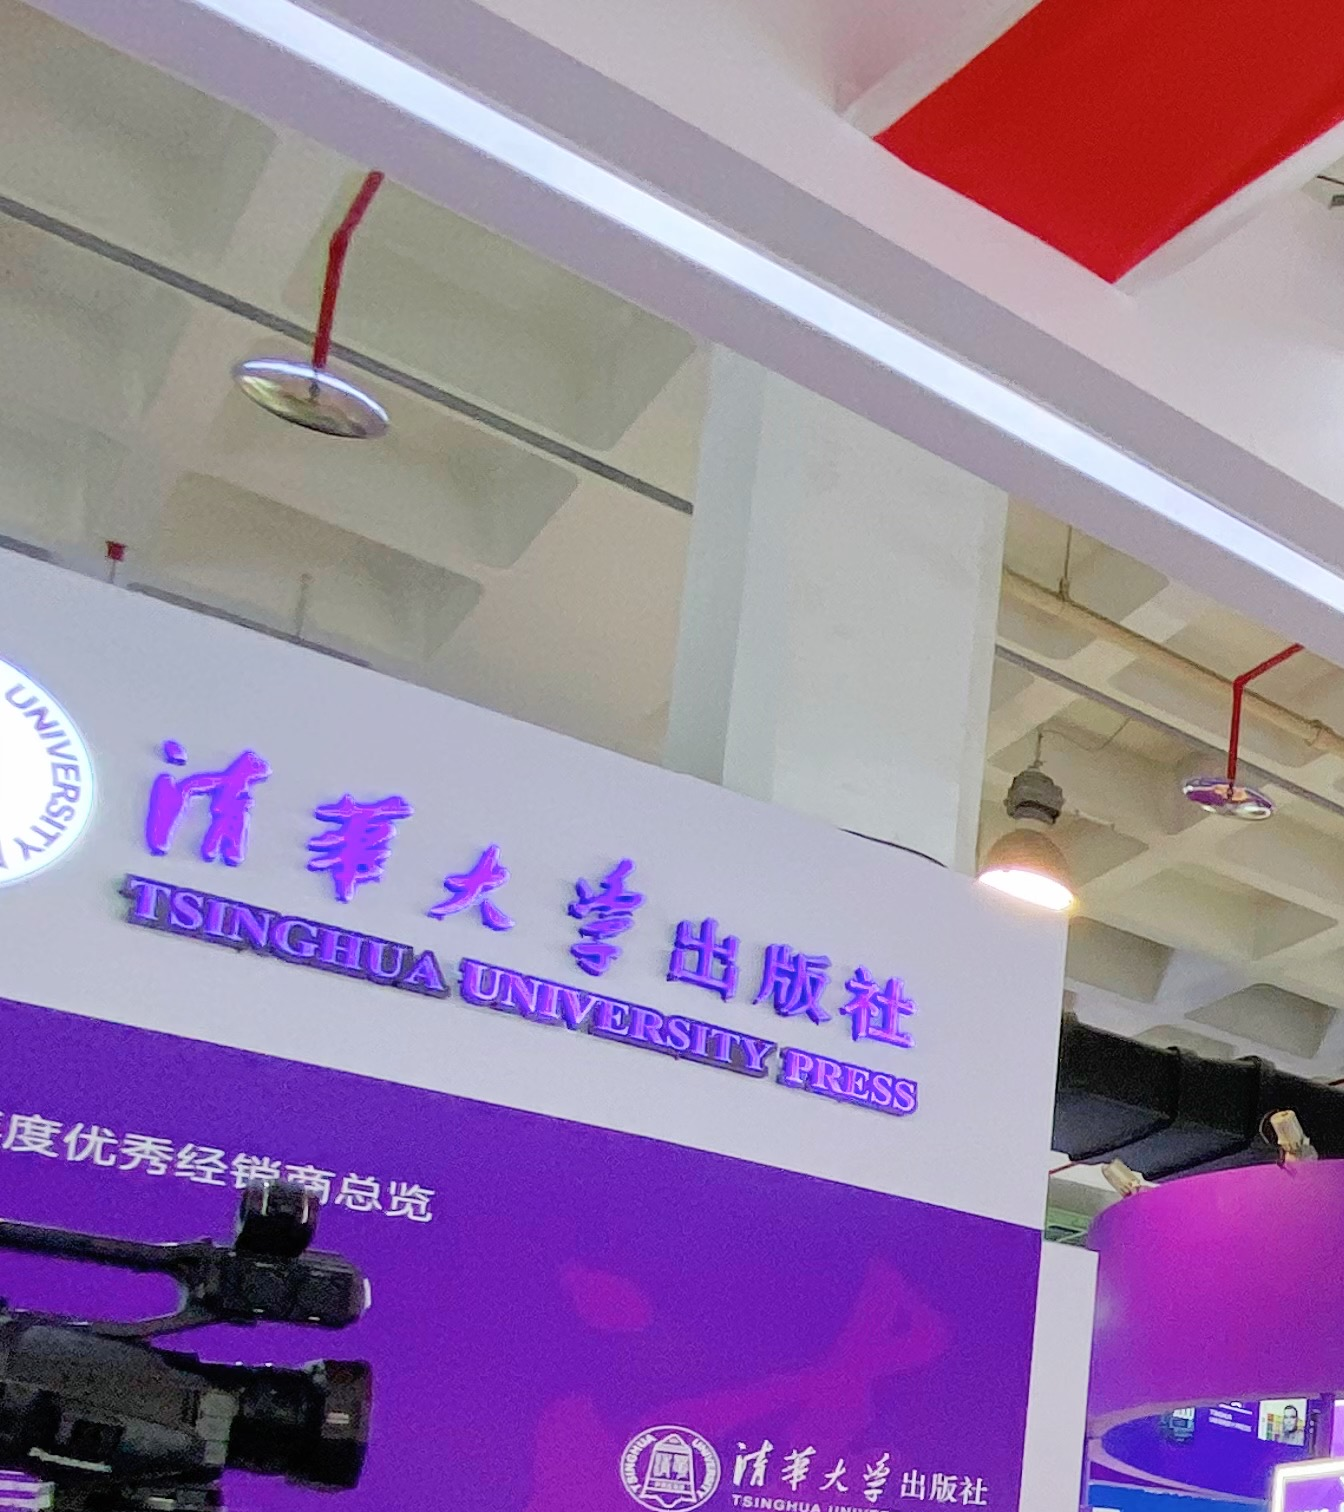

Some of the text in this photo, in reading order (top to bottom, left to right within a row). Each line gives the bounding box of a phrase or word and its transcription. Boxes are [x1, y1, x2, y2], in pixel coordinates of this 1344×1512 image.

[4, 682, 82, 862] UNIVERSITY
[125, 876, 918, 1114] TSINGHUA UNIVERSITY PRESS
[0, 1111, 436, 1223] 度优秀经销商总览
